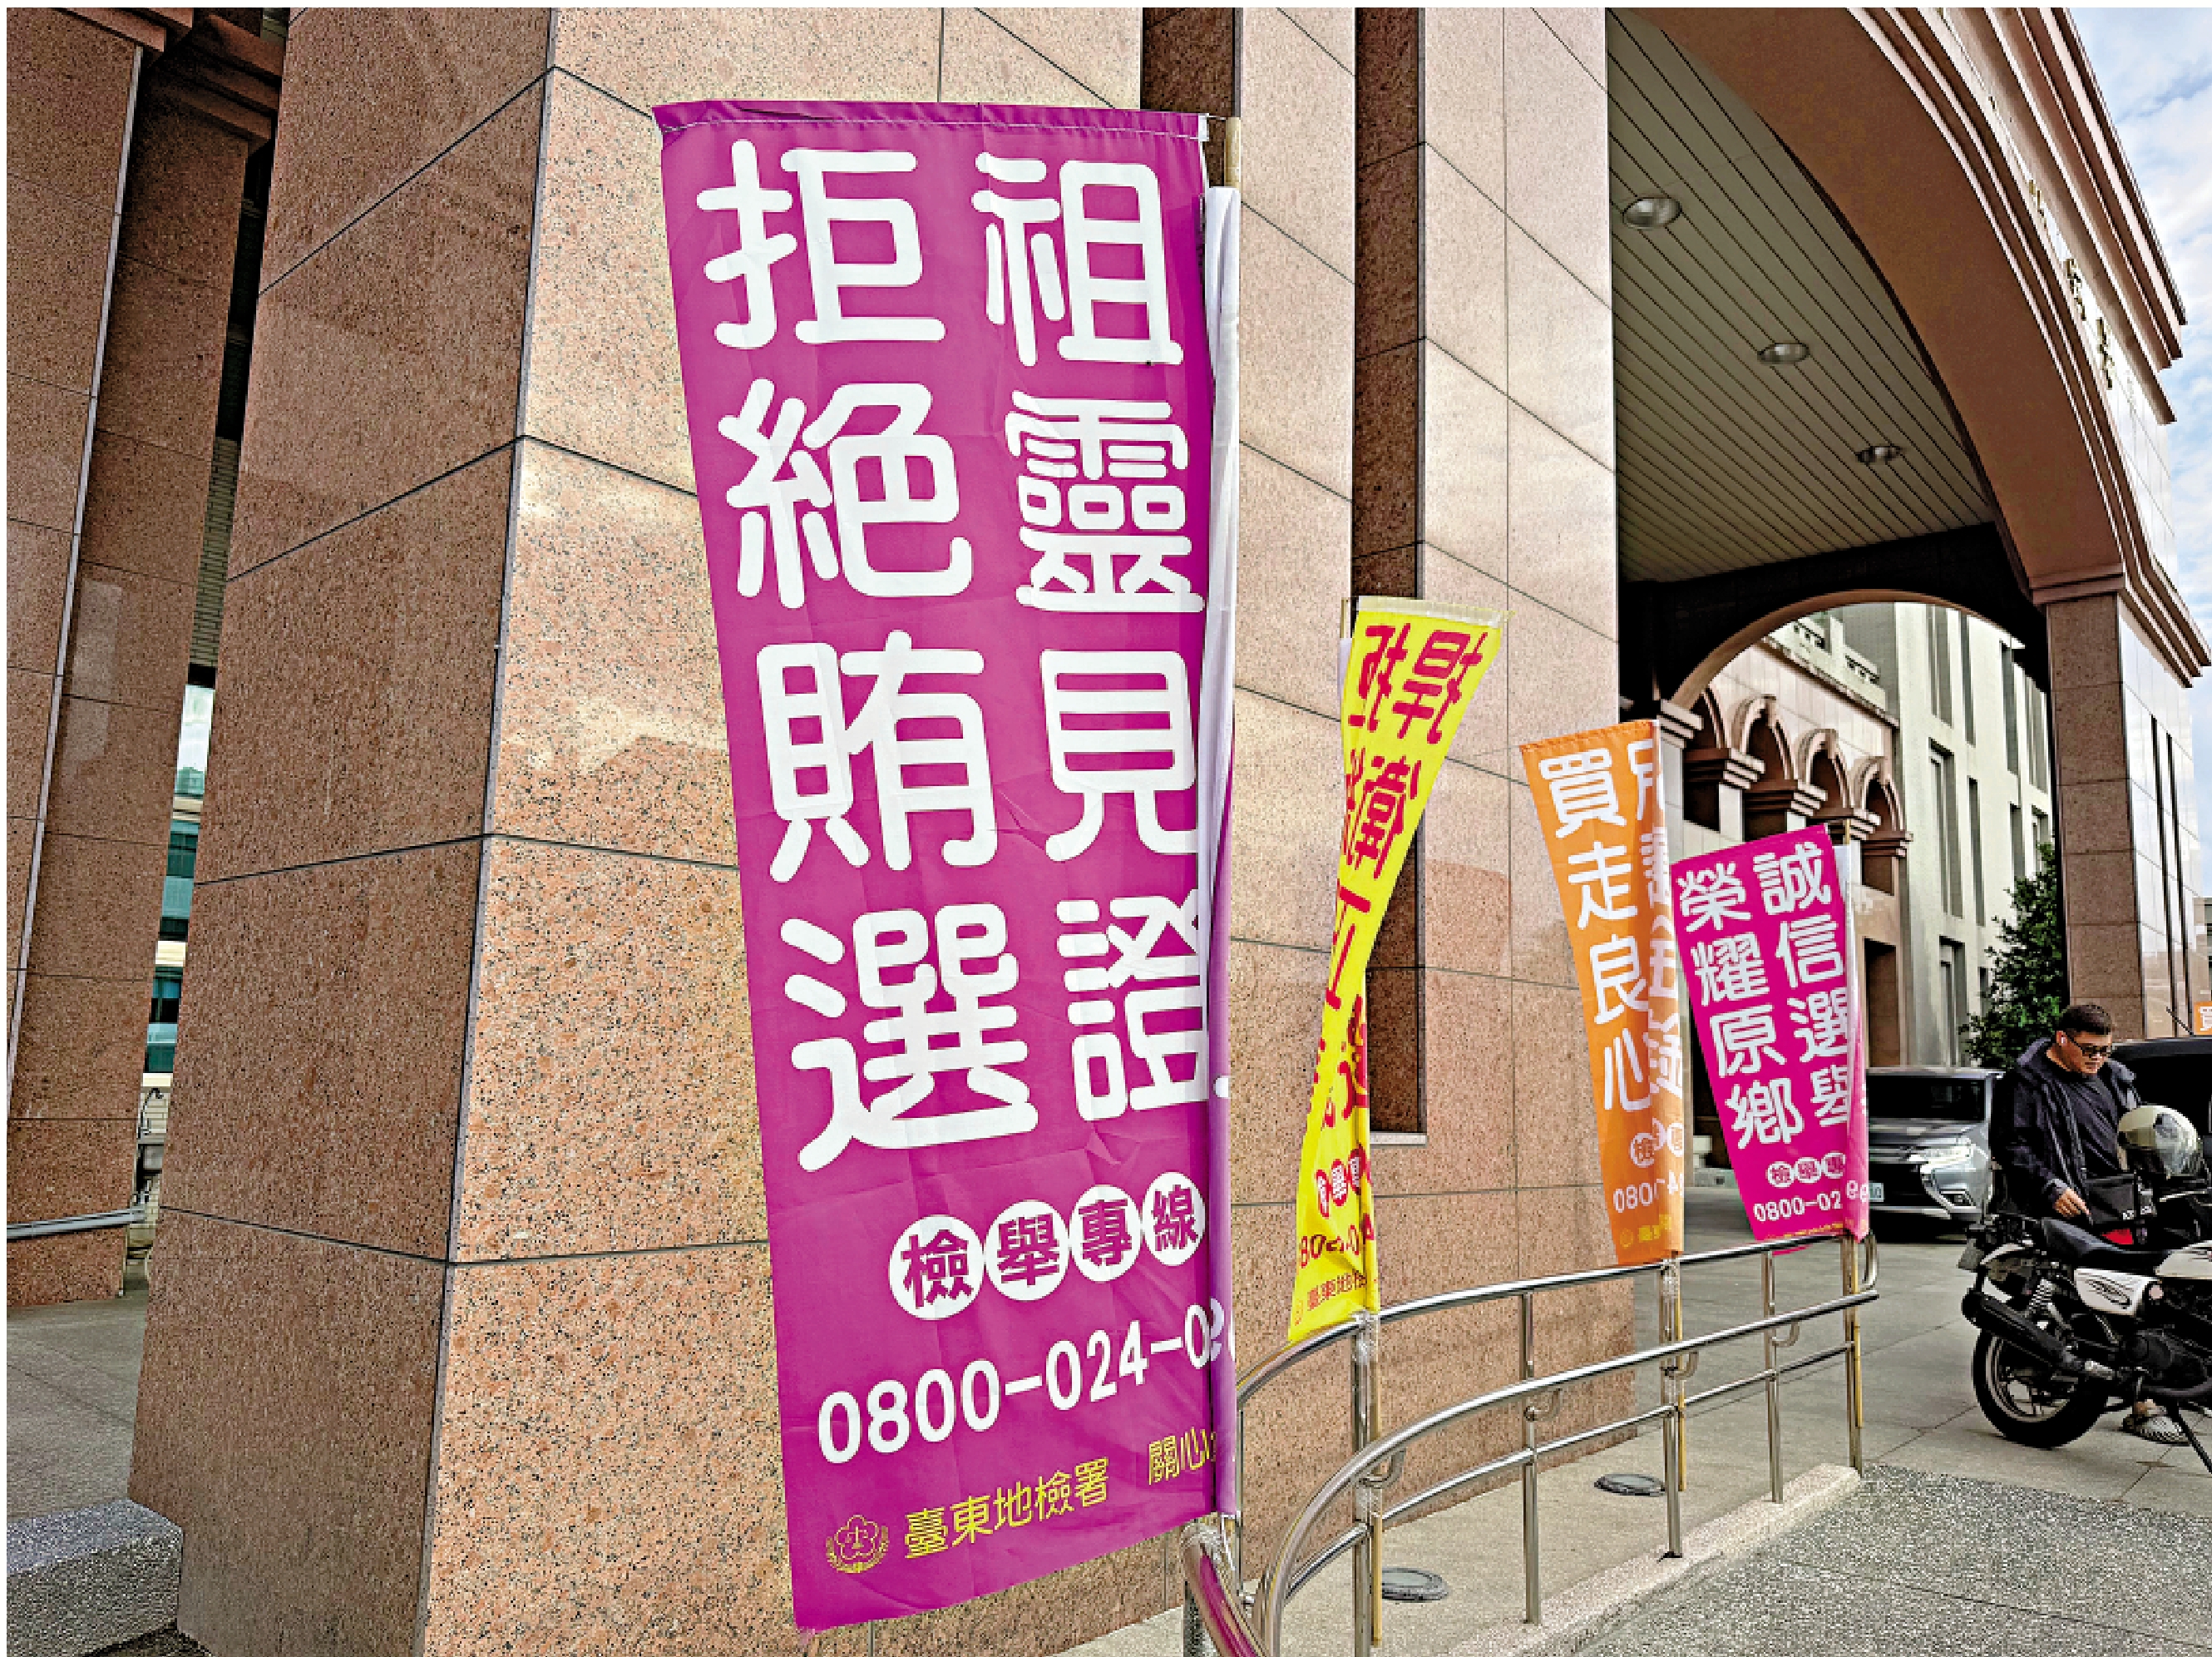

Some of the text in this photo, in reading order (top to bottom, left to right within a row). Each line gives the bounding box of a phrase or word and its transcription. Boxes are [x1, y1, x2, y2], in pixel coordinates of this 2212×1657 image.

[696, 139, 1039, 1173] 拒絕賄選
[971, 152, 1209, 1122] 祖靈見證
[1538, 749, 1653, 1111] 買走良心
[1678, 863, 1803, 1150] 榮耀原鄉
[901, 1184, 1201, 1308] 檢舉專線
[904, 1427, 1217, 1560] 臺東地檢署 關心
